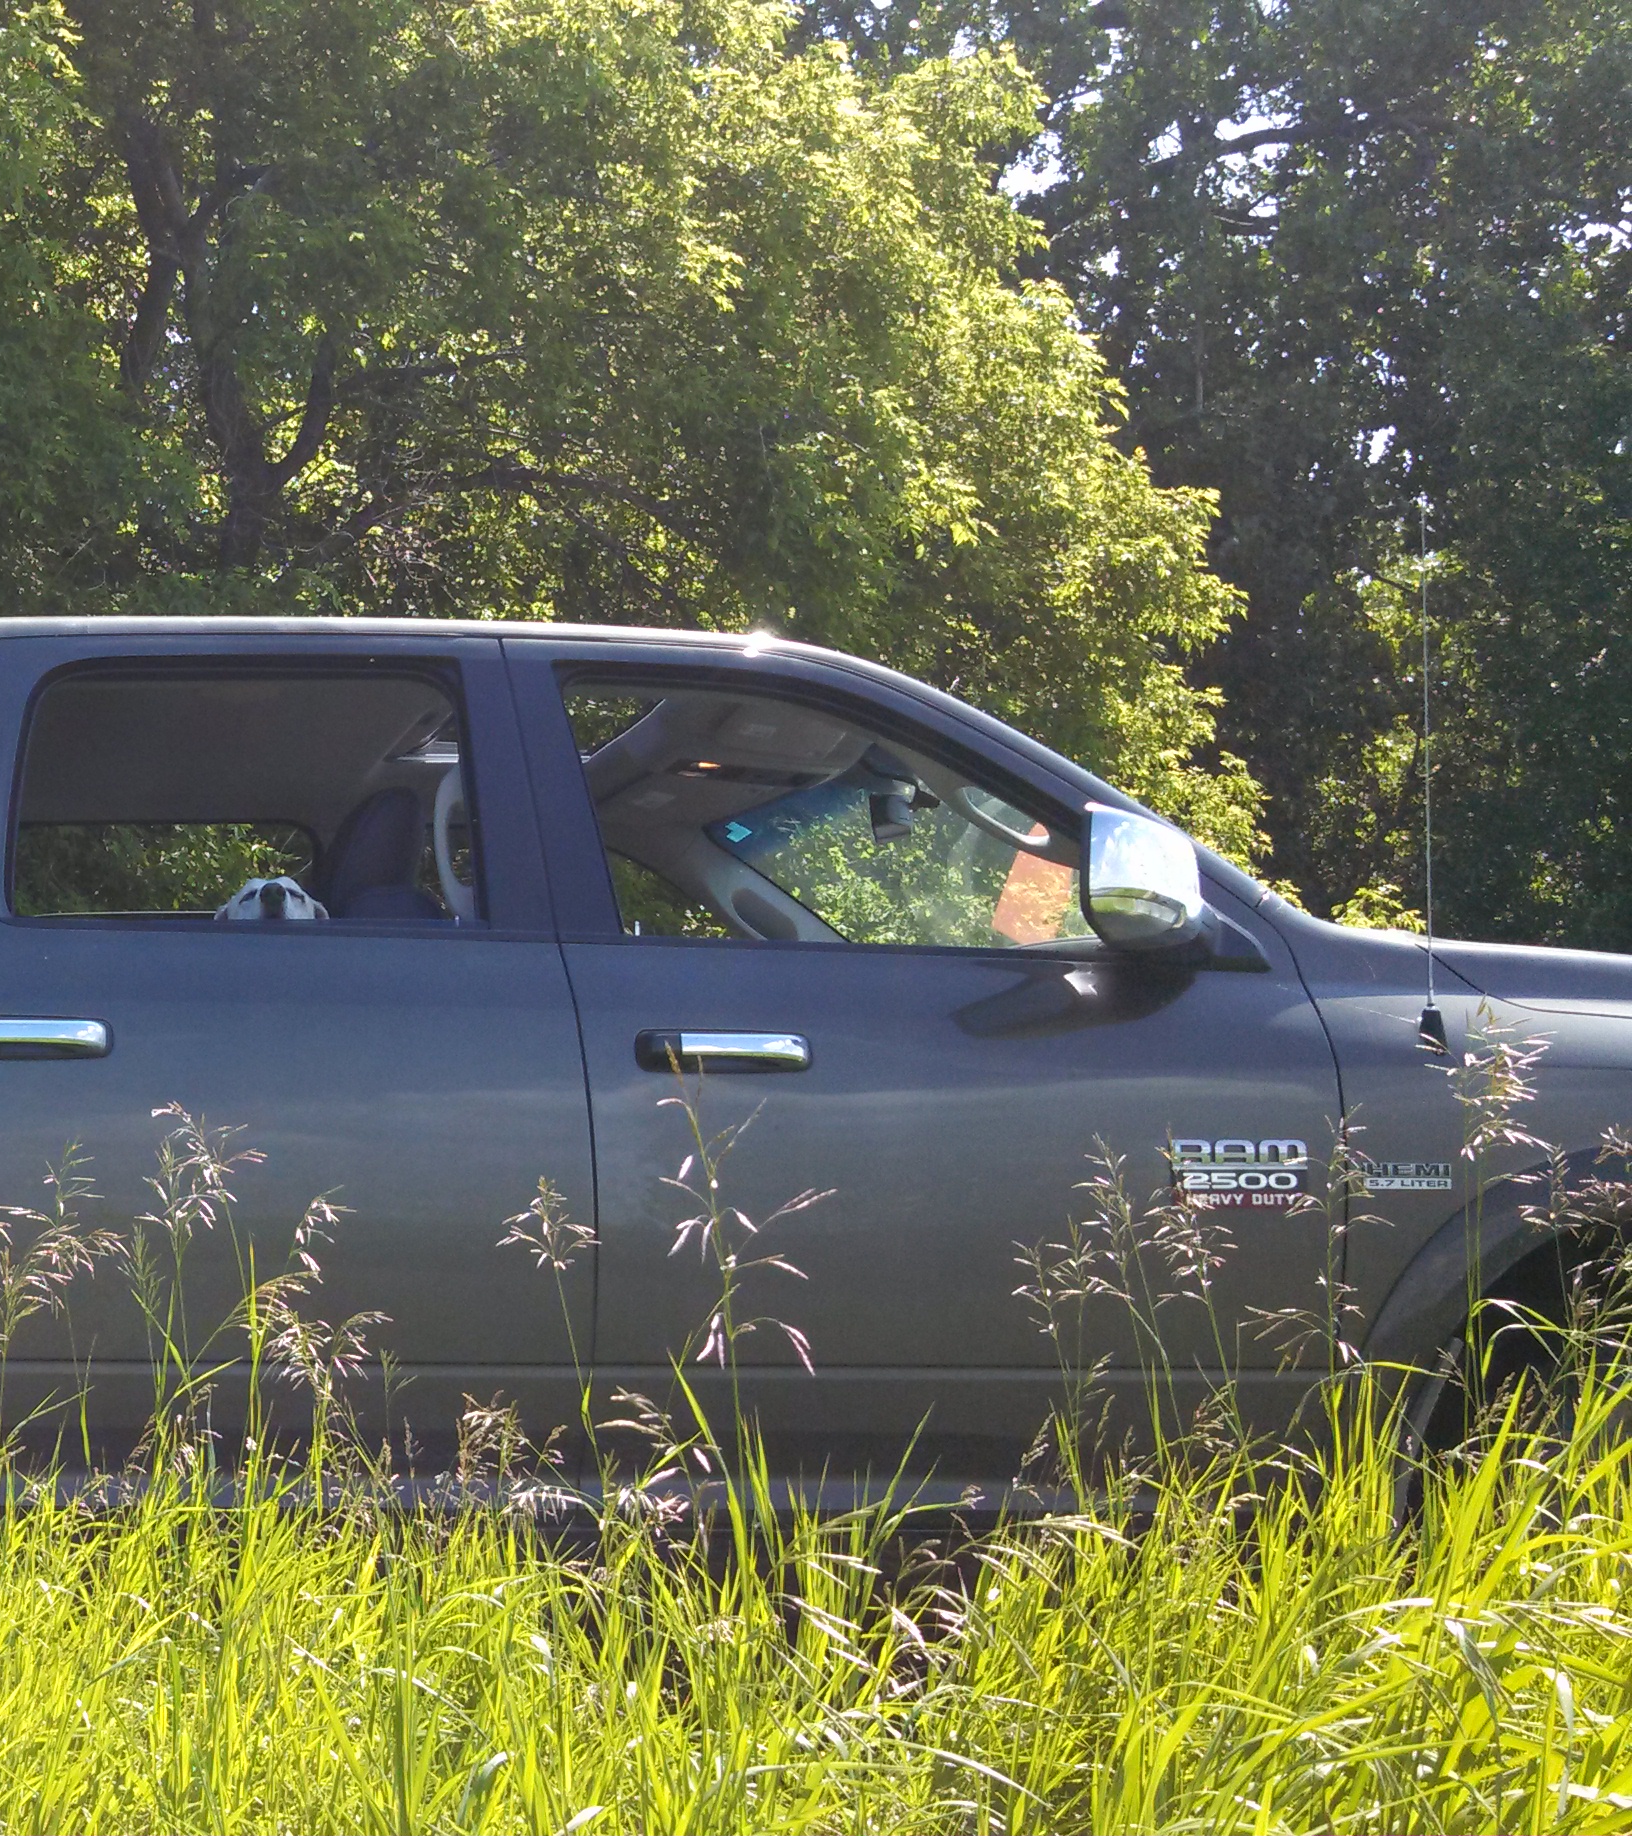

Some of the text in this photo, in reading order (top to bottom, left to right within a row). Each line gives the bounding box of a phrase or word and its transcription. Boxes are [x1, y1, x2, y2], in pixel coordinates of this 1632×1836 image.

[1172, 1139, 1307, 1165] RAM
[1365, 1162, 1451, 1177] HEMI
[1182, 1172, 1298, 1190] 2500
[1369, 1179, 1448, 1188] 5.7 LITER
[1251, 1192, 1296, 1206] DUTY
